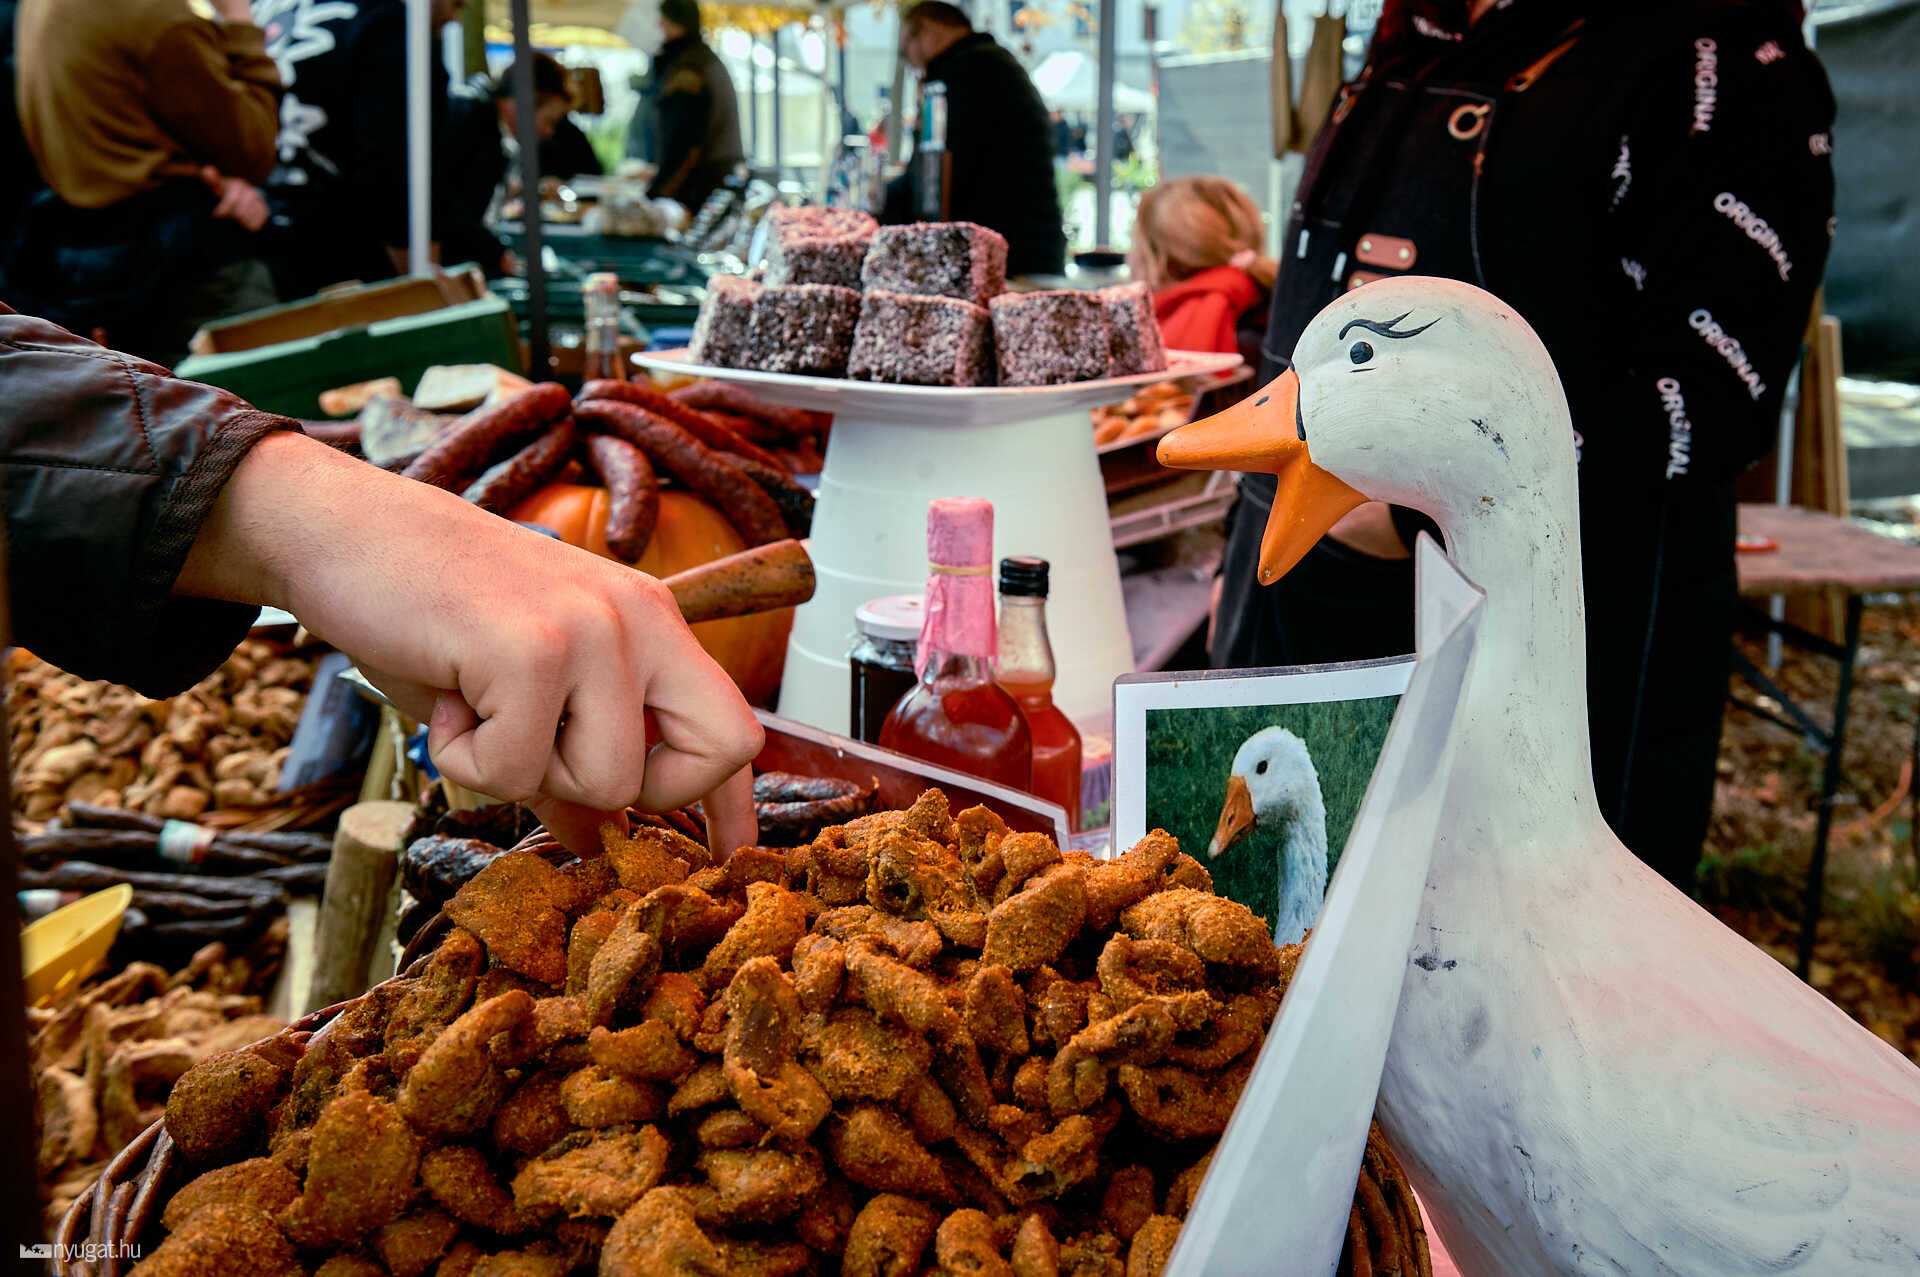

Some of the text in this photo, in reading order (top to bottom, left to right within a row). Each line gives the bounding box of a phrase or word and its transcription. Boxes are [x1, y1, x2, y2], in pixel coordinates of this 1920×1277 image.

[1714, 191, 1793, 281] ORIGINAL
[1688, 308, 1767, 401] ORIGINAL
[1656, 377, 1692, 479] ORIGINAL
